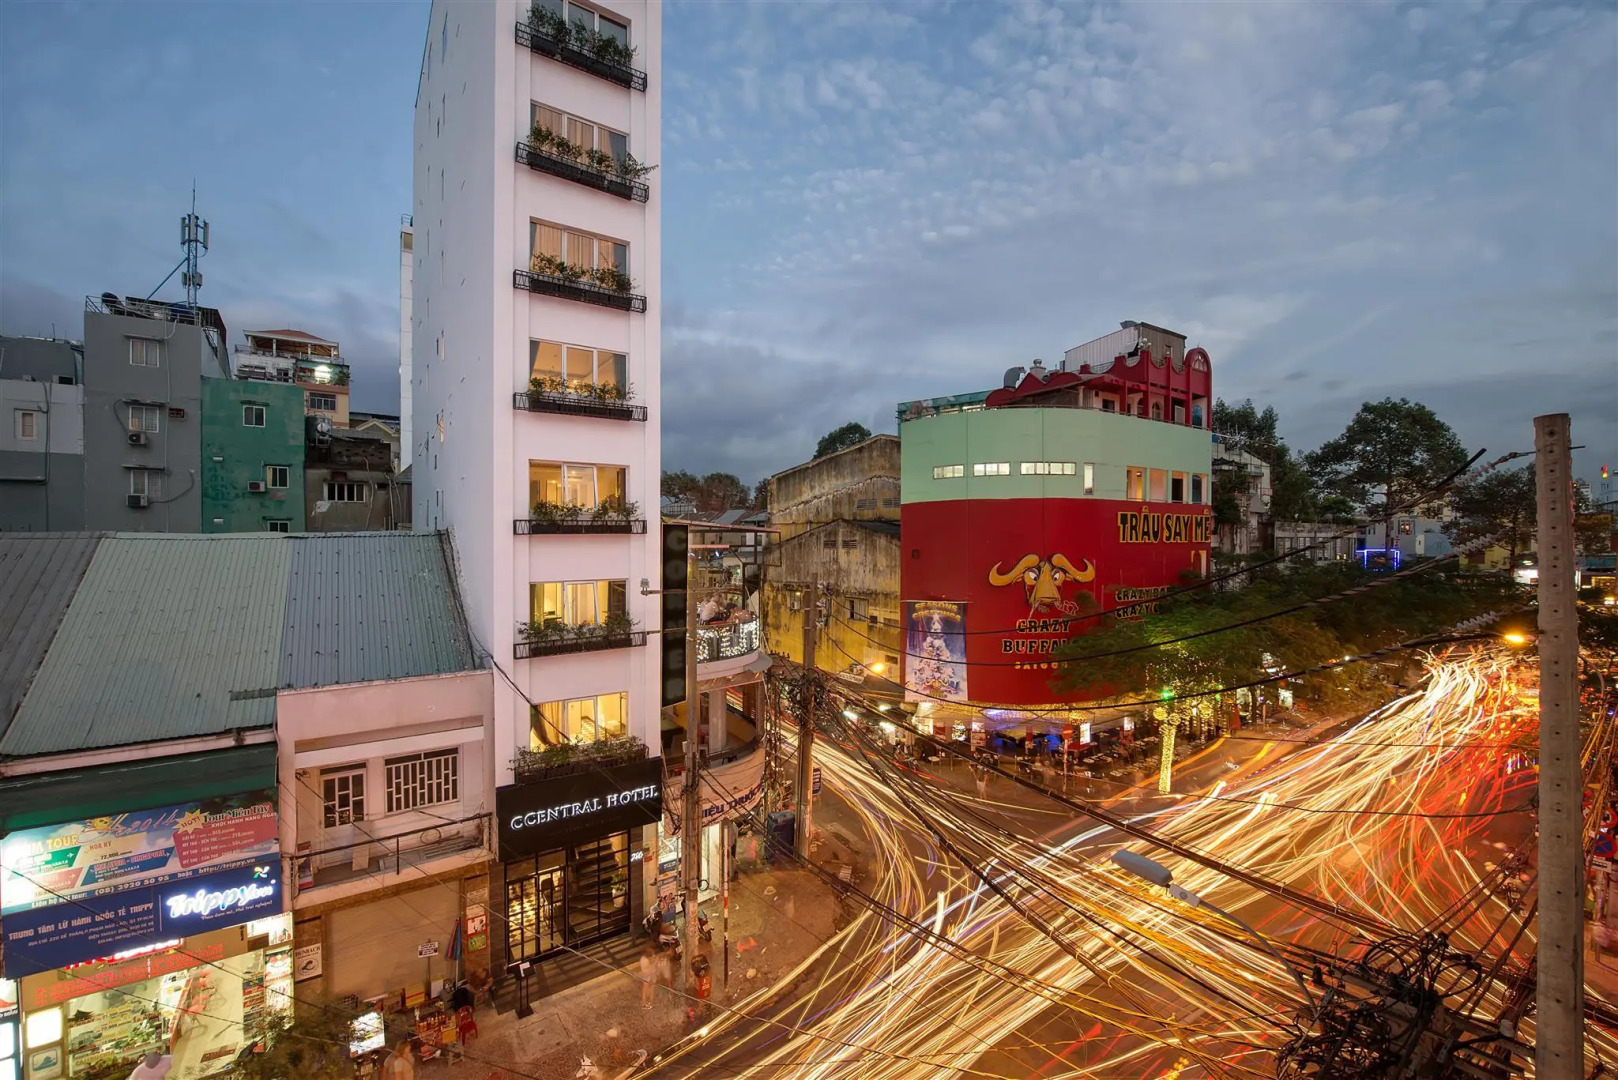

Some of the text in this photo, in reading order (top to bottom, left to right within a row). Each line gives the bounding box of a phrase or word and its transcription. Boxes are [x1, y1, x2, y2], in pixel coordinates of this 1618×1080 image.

[1118, 505, 1161, 543] TRÂU
[1163, 513, 1191, 543] SAY
[1016, 618, 1071, 633] CRAZY
[1002, 639, 1068, 654] BUFFA
[510, 798, 602, 830] CCENTRAL
[606, 785, 659, 808] HOTEL
[46, 834, 78, 849] TOUR
[8, 929, 34, 940] TRUNG
